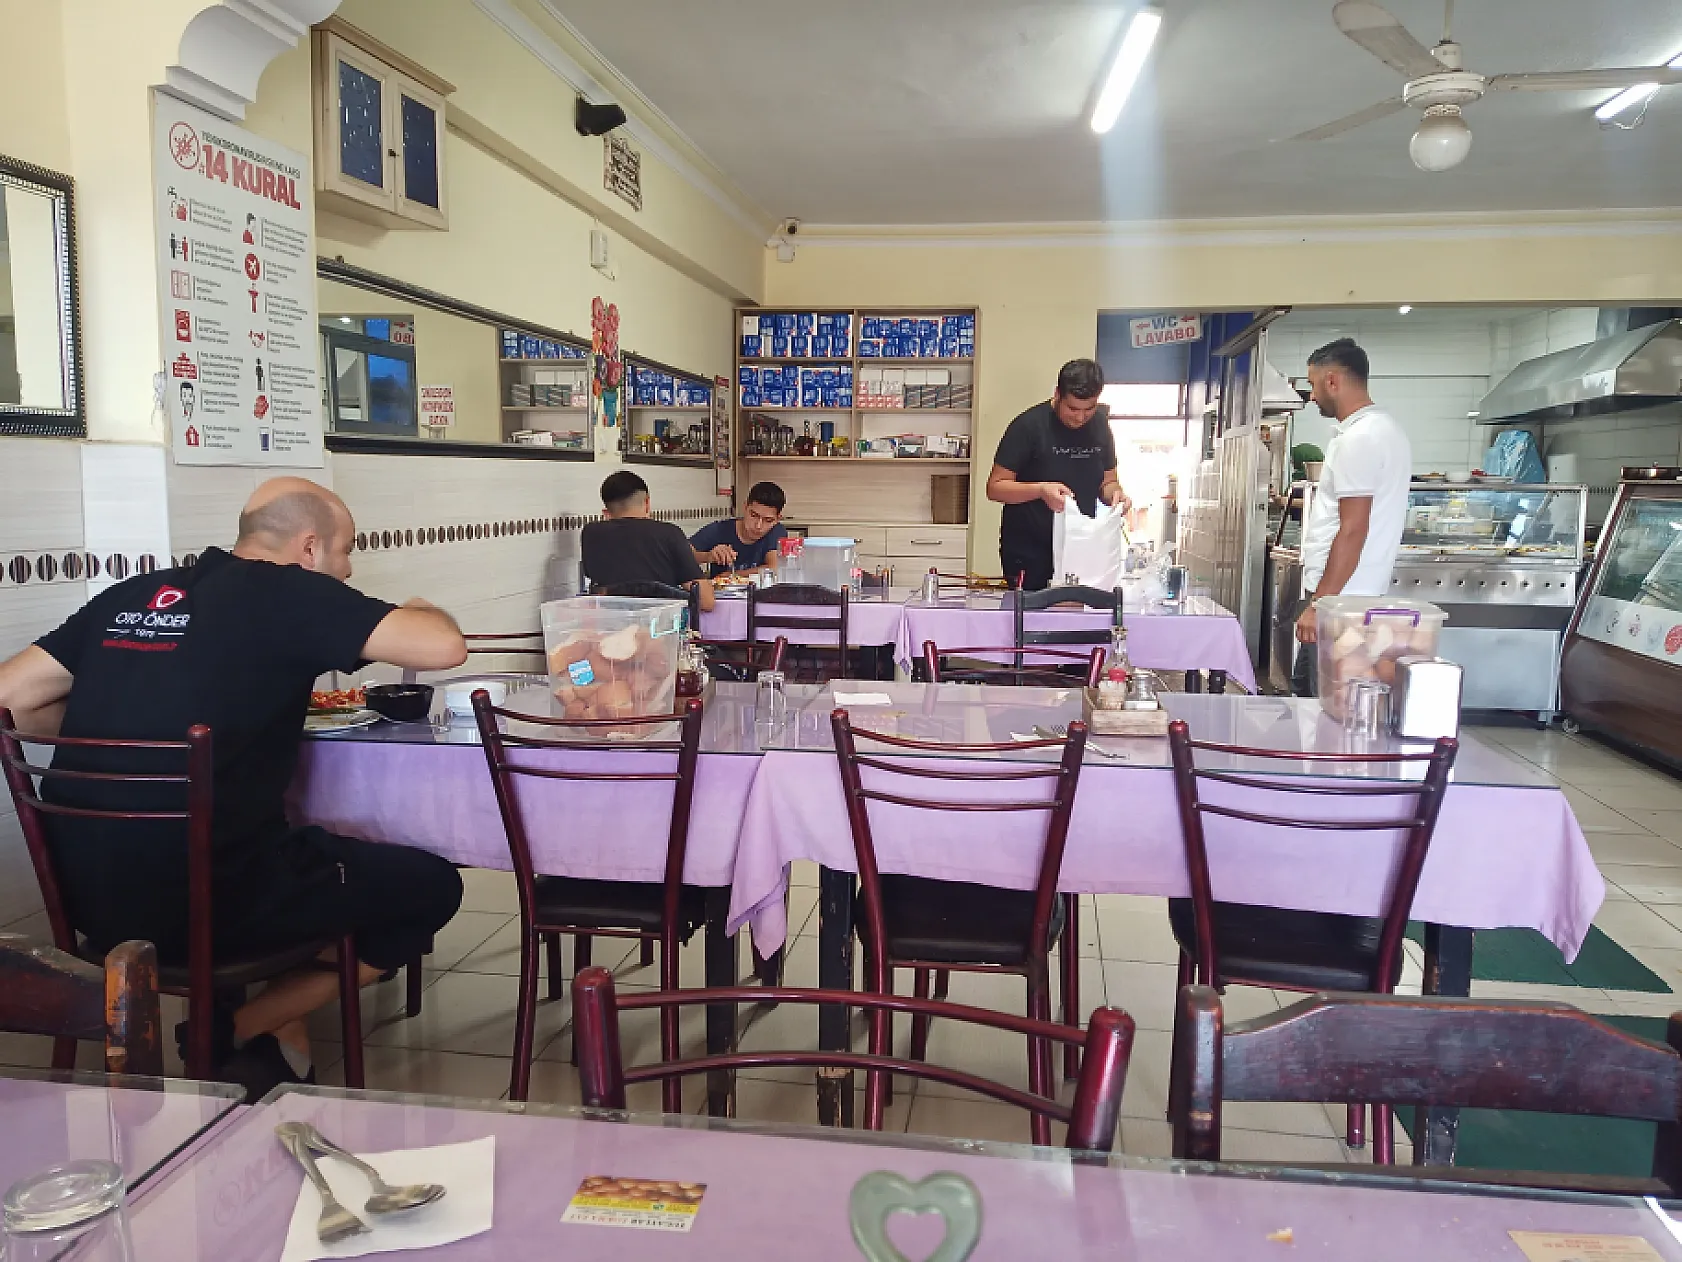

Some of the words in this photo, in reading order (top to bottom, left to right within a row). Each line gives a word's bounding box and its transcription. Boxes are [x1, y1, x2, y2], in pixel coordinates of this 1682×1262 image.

[202, 145, 228, 183] 14
[232, 156, 301, 210] KURAL
[1151, 316, 1177, 330] WC
[1136, 327, 1195, 347] LAVABO
